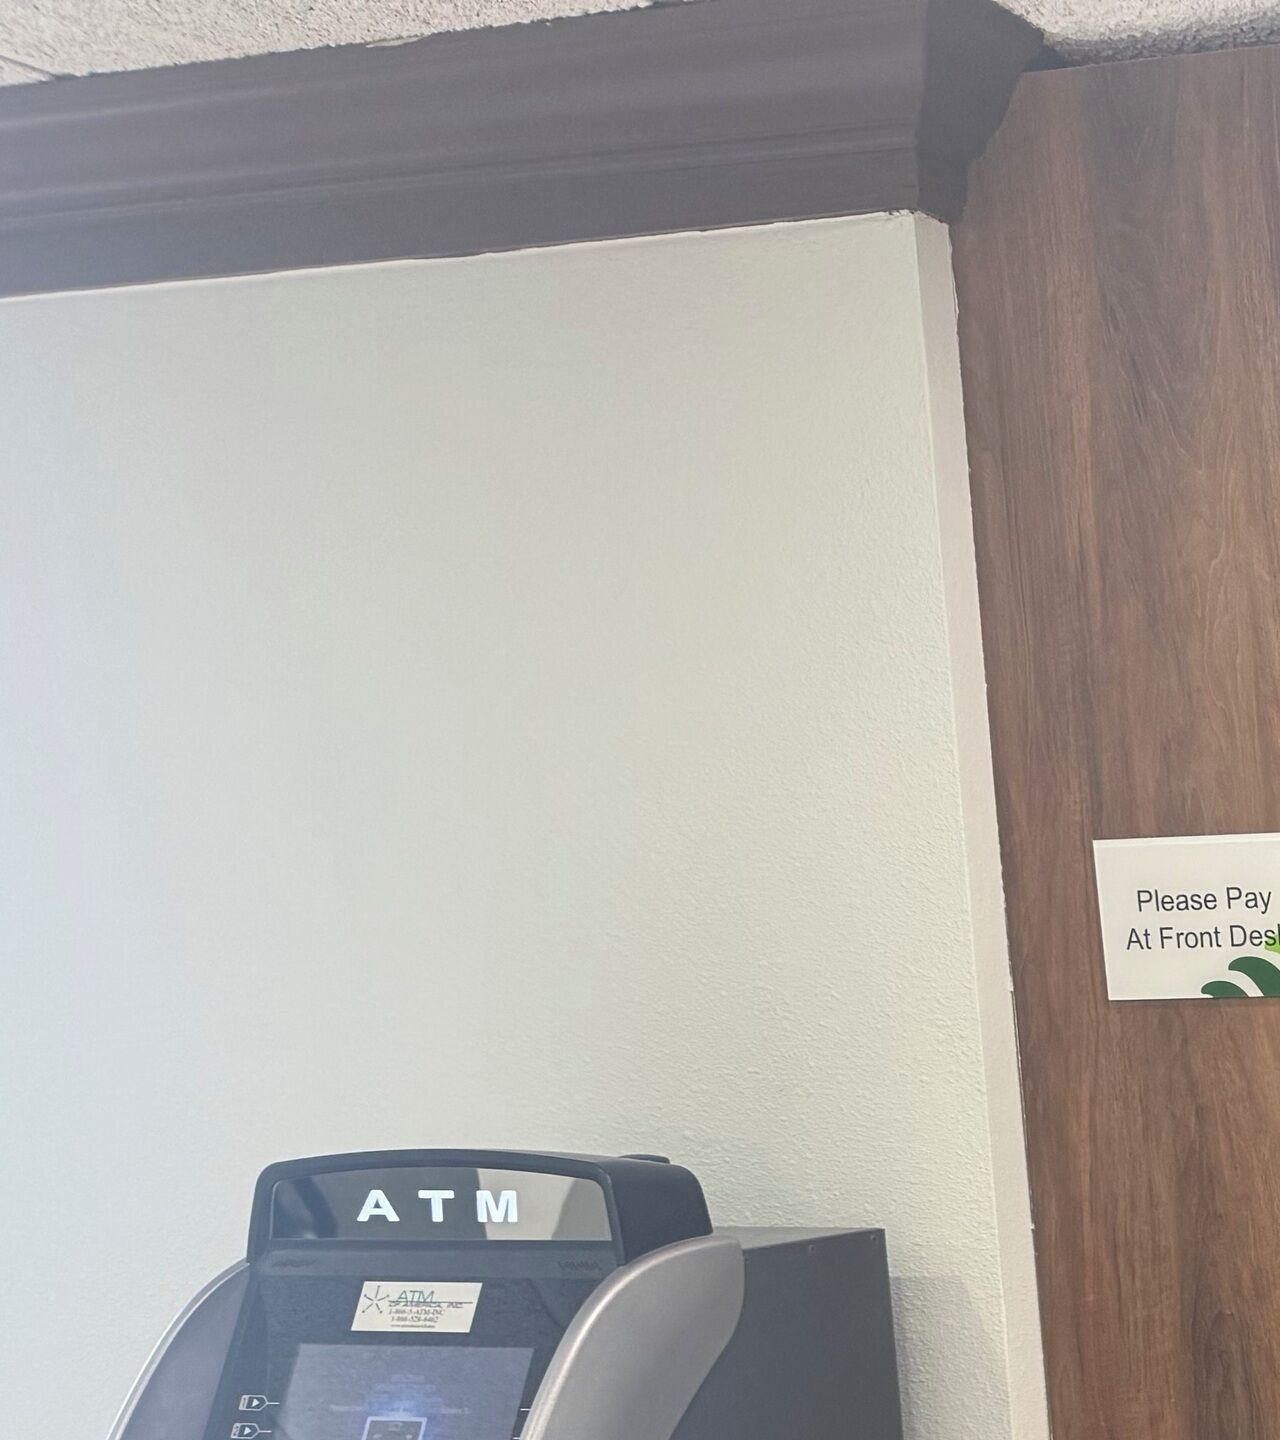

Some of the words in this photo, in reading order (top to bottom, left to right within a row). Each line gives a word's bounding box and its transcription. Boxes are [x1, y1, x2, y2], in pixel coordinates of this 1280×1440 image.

[1137, 889, 1217, 912] Please
[1226, 887, 1272, 915] Pay
[1127, 928, 1152, 950] At
[1159, 926, 1222, 949] Front
[356, 1189, 519, 1223] ATM
